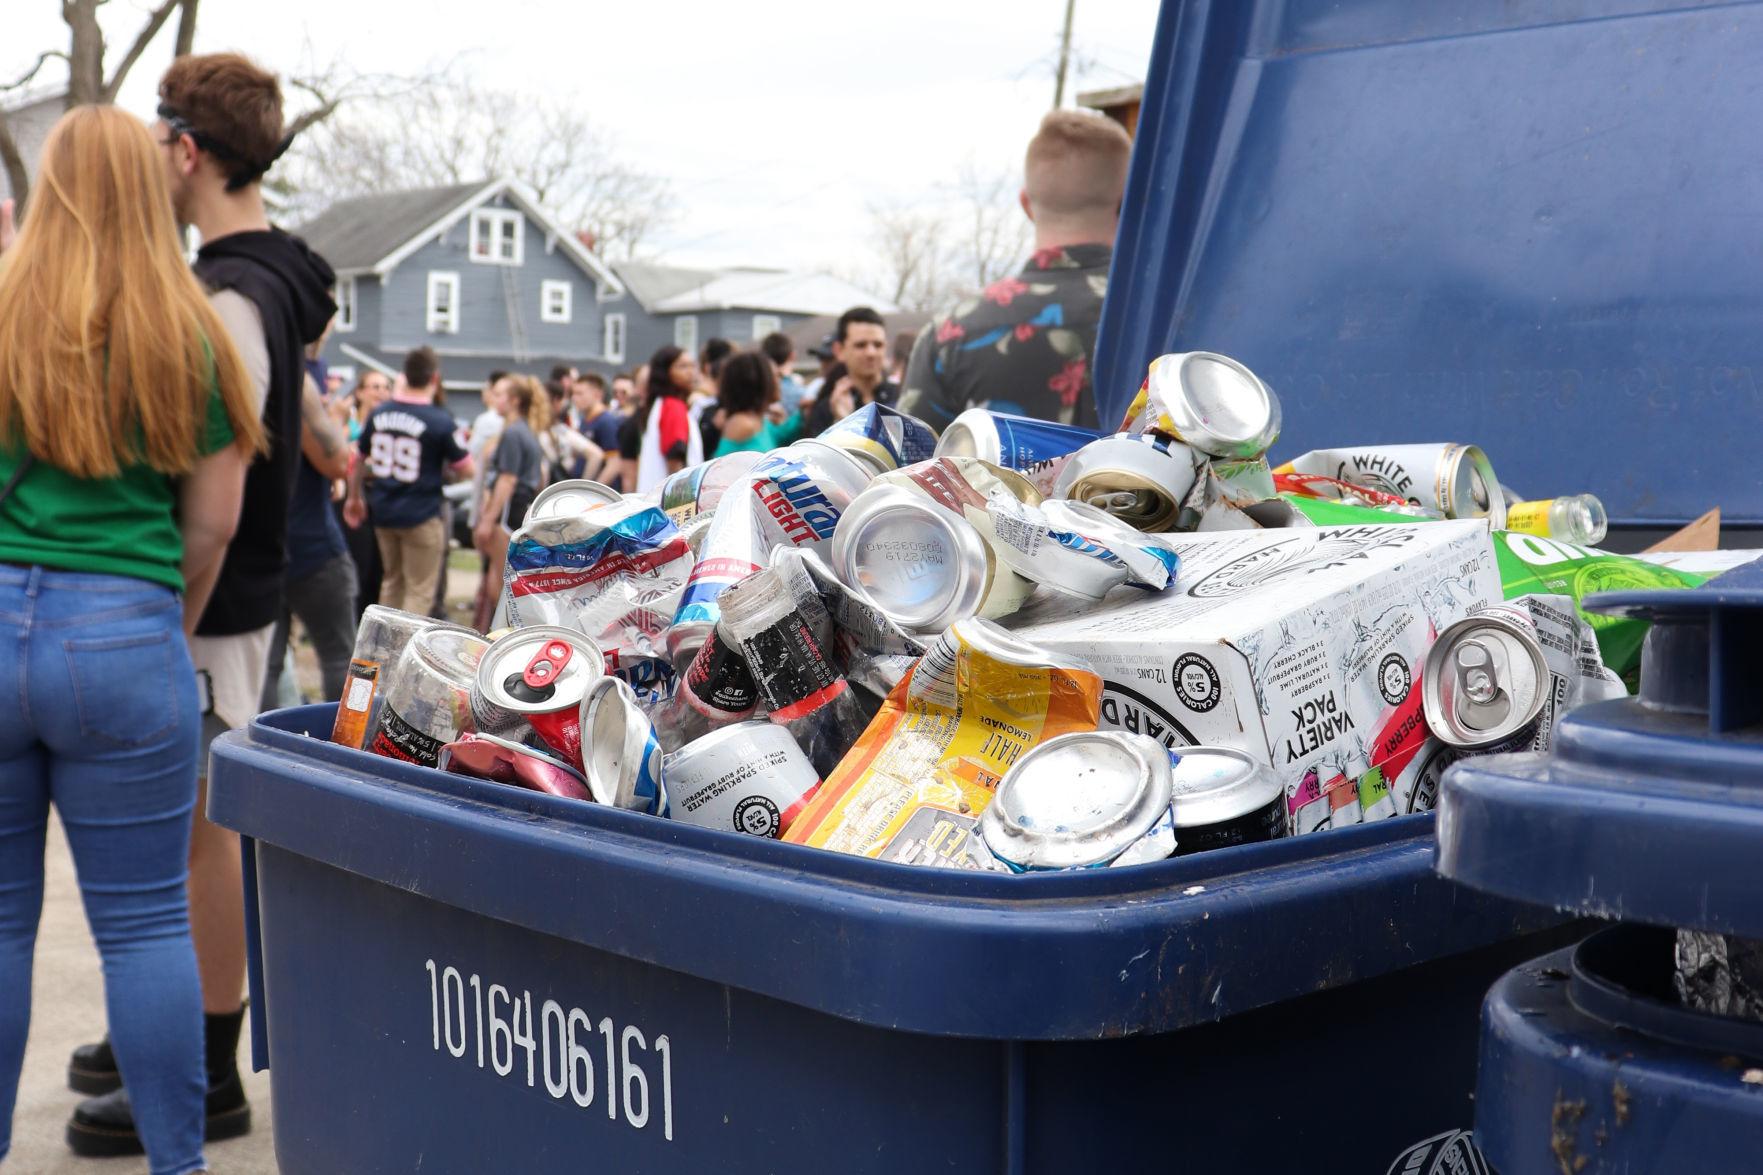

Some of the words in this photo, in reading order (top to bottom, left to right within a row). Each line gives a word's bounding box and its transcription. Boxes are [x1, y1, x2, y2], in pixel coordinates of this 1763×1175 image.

[370, 432, 421, 482] 99
[1352, 453, 1413, 493] WHITE
[752, 479, 820, 545] LIGHT
[1216, 547, 1281, 579] HARD
[1395, 614, 1415, 635] SPIKED
[1298, 644, 1316, 657] BLACK
[1368, 632, 1396, 664] SPARKLING
[1186, 656, 1210, 670] NATURAL
[1274, 654, 1297, 669] CHERRY
[1303, 655, 1318, 667] RUBY
[1137, 668, 1155, 679] CANS
[1155, 669, 1167, 684] 12
[1209, 668, 1218, 682] ALL
[1267, 663, 1303, 685] GRAPEFRUIT
[1295, 666, 1321, 683] NATURAL
[1350, 663, 1368, 683] WATER
[1187, 682, 1206, 693] 5%
[1211, 686, 1219, 701] 100
[1280, 679, 1294, 691] LIME
[1290, 677, 1323, 698] RASPBERRY
[1177, 686, 1213, 710] CALORIES
[1384, 686, 1409, 704] CALORIES
[1291, 690, 1337, 732] PACK
[979, 715, 1032, 743] LEMONADE
[1286, 709, 1355, 764] VARIETY
[770, 750, 786, 758] WITH
[980, 732, 1022, 766] HALF
[735, 766, 745, 774] OF
[759, 756, 787, 771] SPIKED
[712, 769, 757, 797] SPARKLING
[717, 772, 735, 786] RUBY
[681, 782, 717, 807] GRAPEFRUIT
[687, 795, 713, 812] WATER
[885, 789, 913, 818] PLEASE
[749, 816, 768, 832] 5%
[426, 959, 672, 1141] 1016406161
